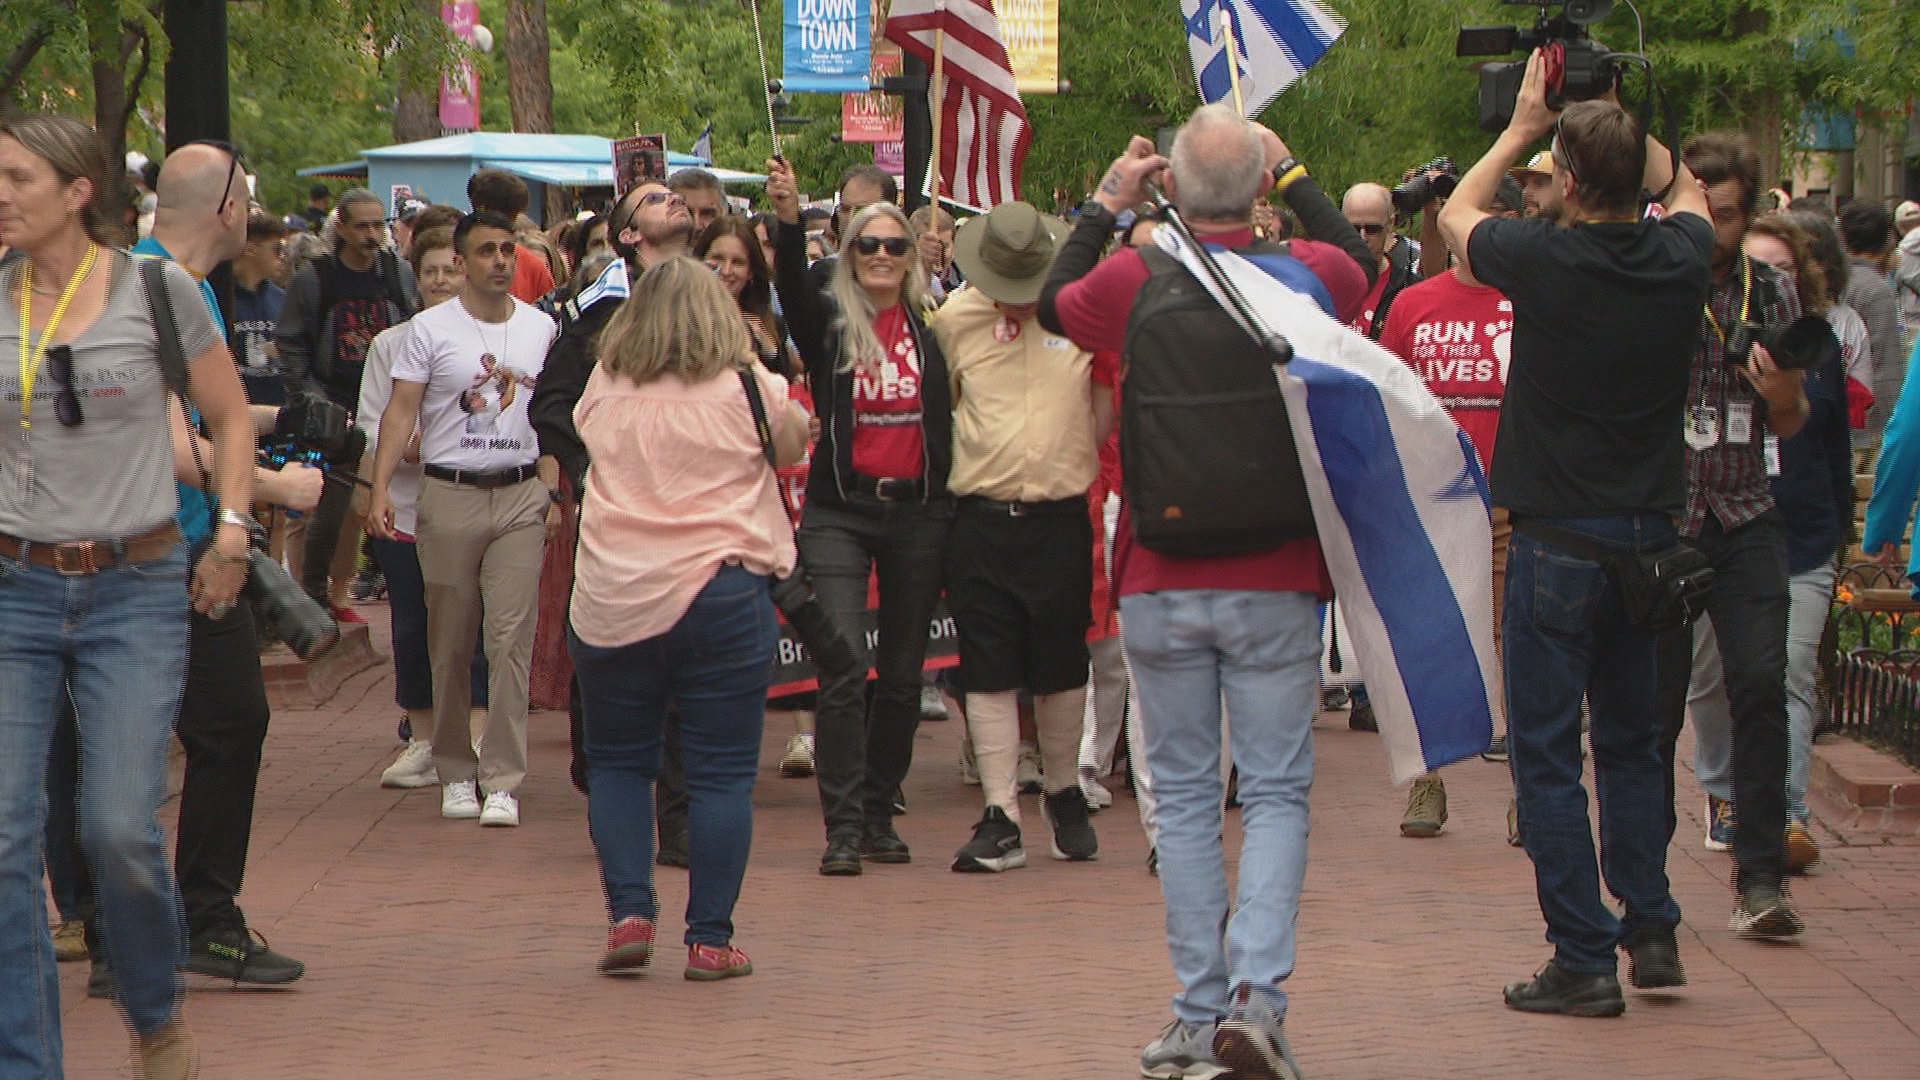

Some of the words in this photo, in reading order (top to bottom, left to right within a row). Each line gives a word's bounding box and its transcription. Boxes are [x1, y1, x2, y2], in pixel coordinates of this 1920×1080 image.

[797, 0, 857, 20] DOWN
[995, 0, 1044, 20] OWN
[797, 19, 857, 51] TOWN
[998, 20, 1044, 53] OWN
[851, 94, 892, 116] TOWN
[1413, 320, 1477, 344] RUN
[1412, 343, 1438, 360] FOR
[1441, 343, 1482, 358] THEIR
[1413, 358, 1495, 382] LIVES
[851, 375, 918, 402] IVES
[460, 437, 487, 451] OMRI
